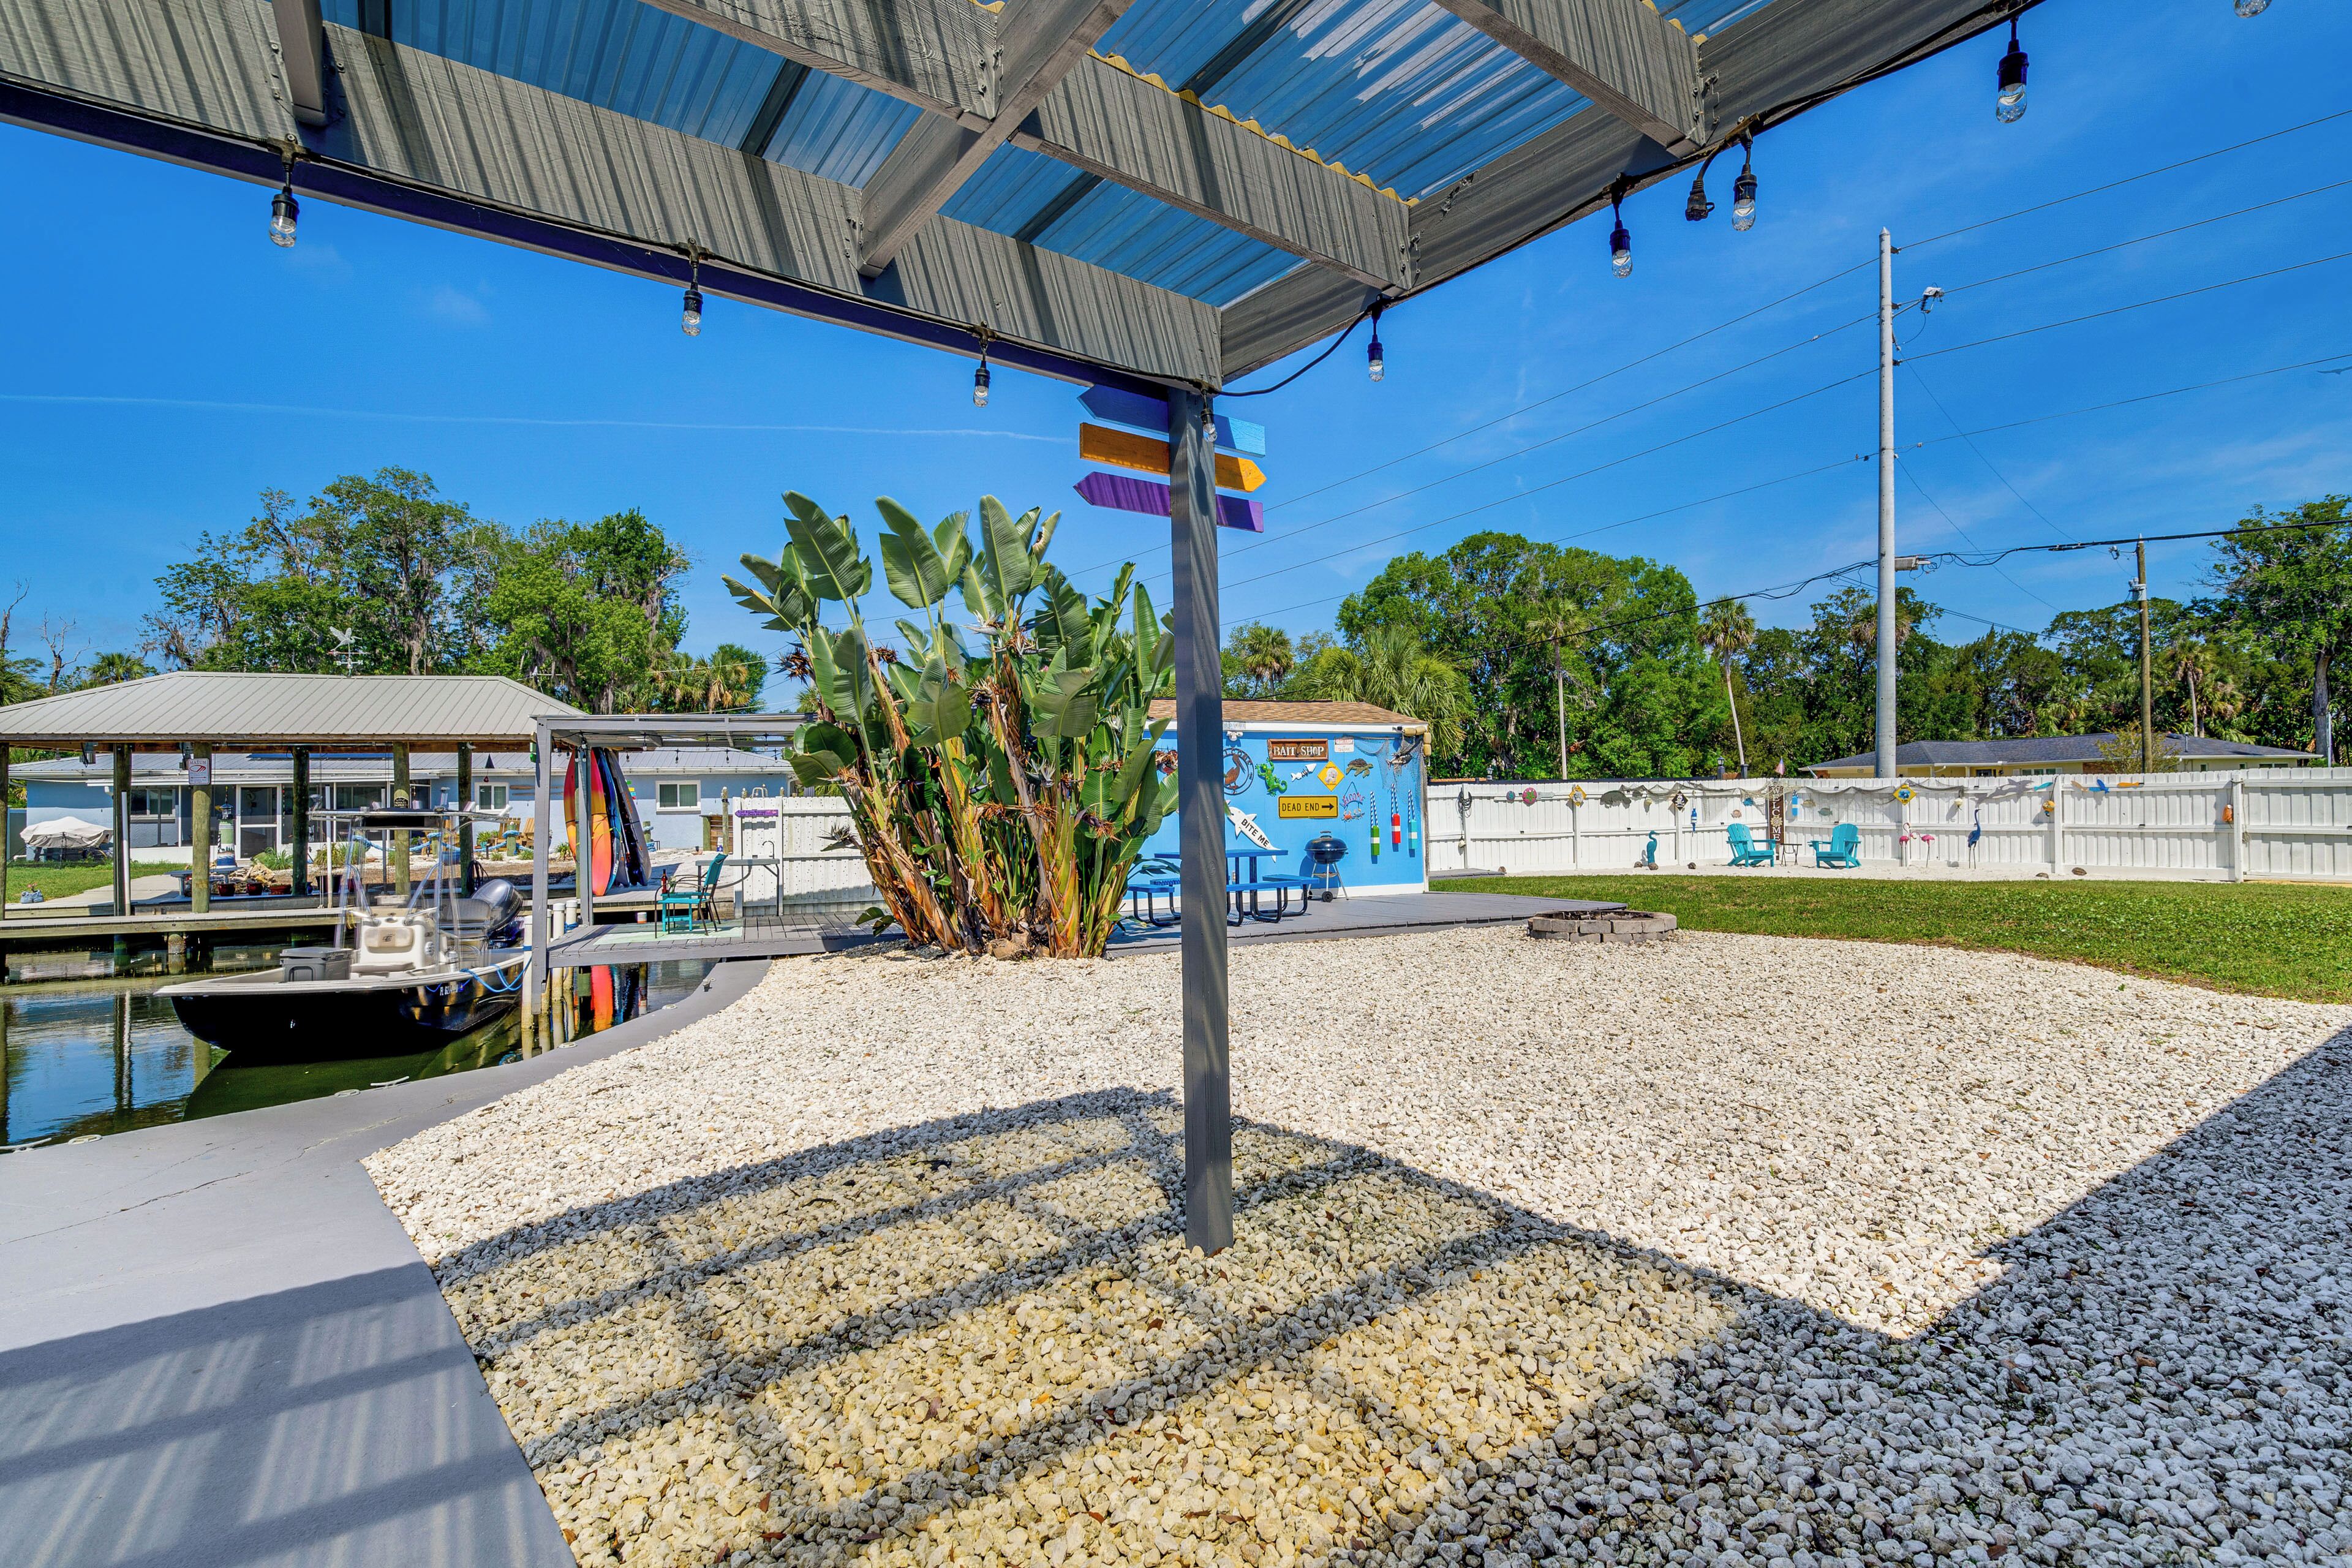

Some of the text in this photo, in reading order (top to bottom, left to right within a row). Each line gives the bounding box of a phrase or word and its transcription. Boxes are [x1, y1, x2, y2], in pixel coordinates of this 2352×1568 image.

[1273, 746, 1324, 756] BAIT SHOP
[1282, 803, 1302, 812] DEAD
[1241, 818, 1270, 847] BITE ME
